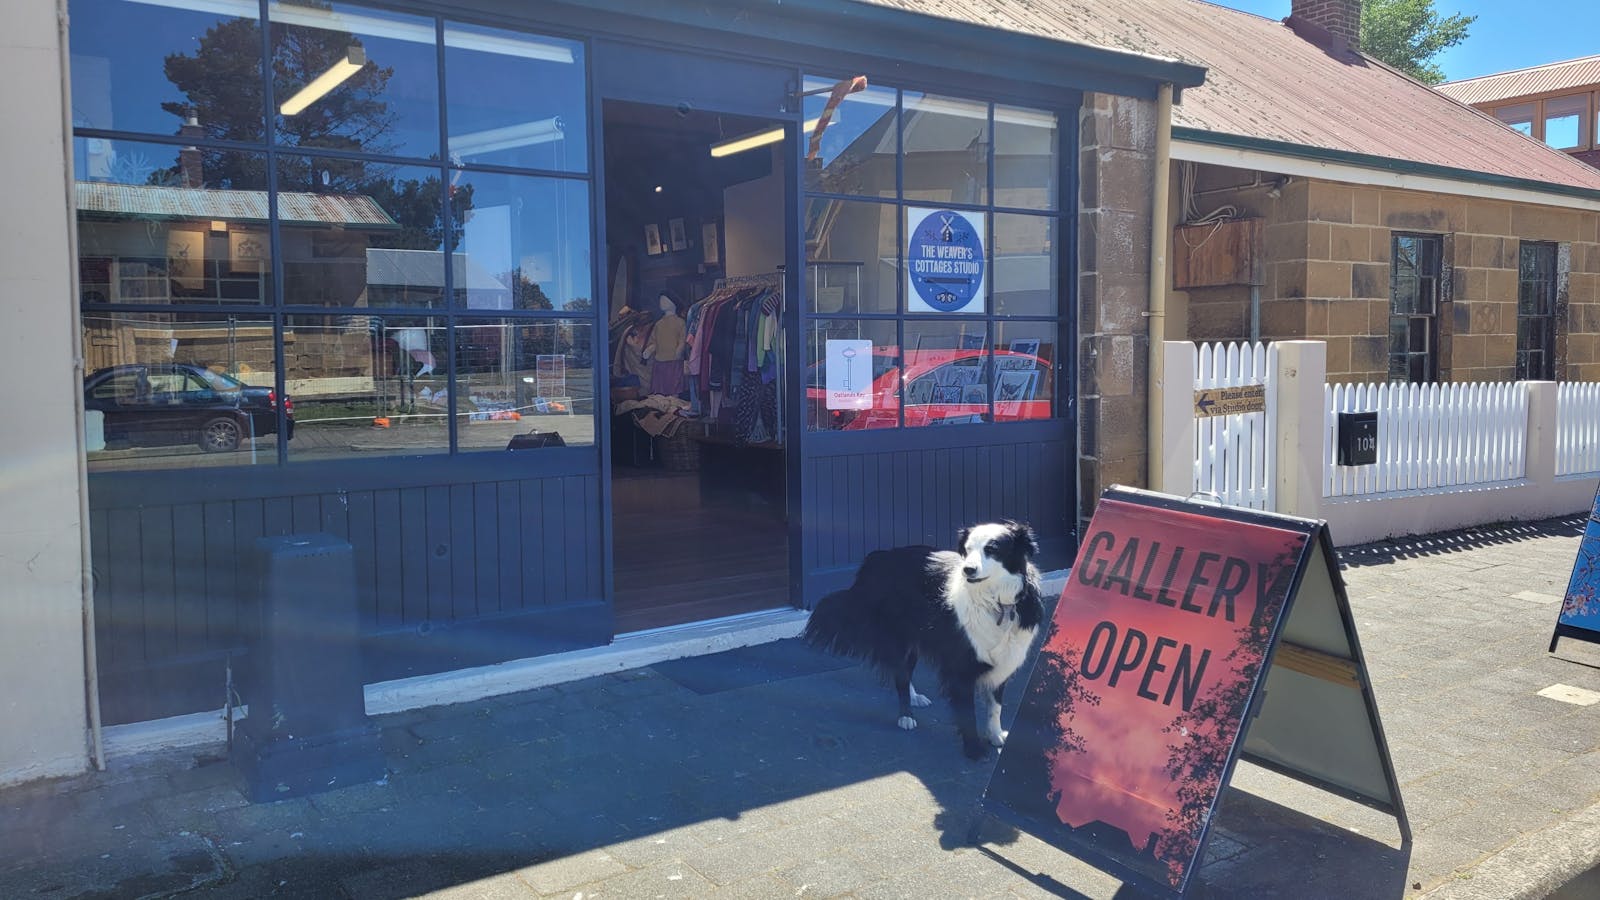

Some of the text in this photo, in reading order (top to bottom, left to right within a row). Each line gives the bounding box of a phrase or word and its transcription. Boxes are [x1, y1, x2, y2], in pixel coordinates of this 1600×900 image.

[921, 244, 973, 259] THE WEAVER'S
[915, 260, 980, 274] COTTAGES STUDIO
[1220, 390, 1243, 401] Please
[1210, 406, 1222, 414] via
[1223, 402, 1245, 414] Studio
[1077, 530, 1294, 628] GALLERY
[1080, 620, 1212, 713] OPEN
